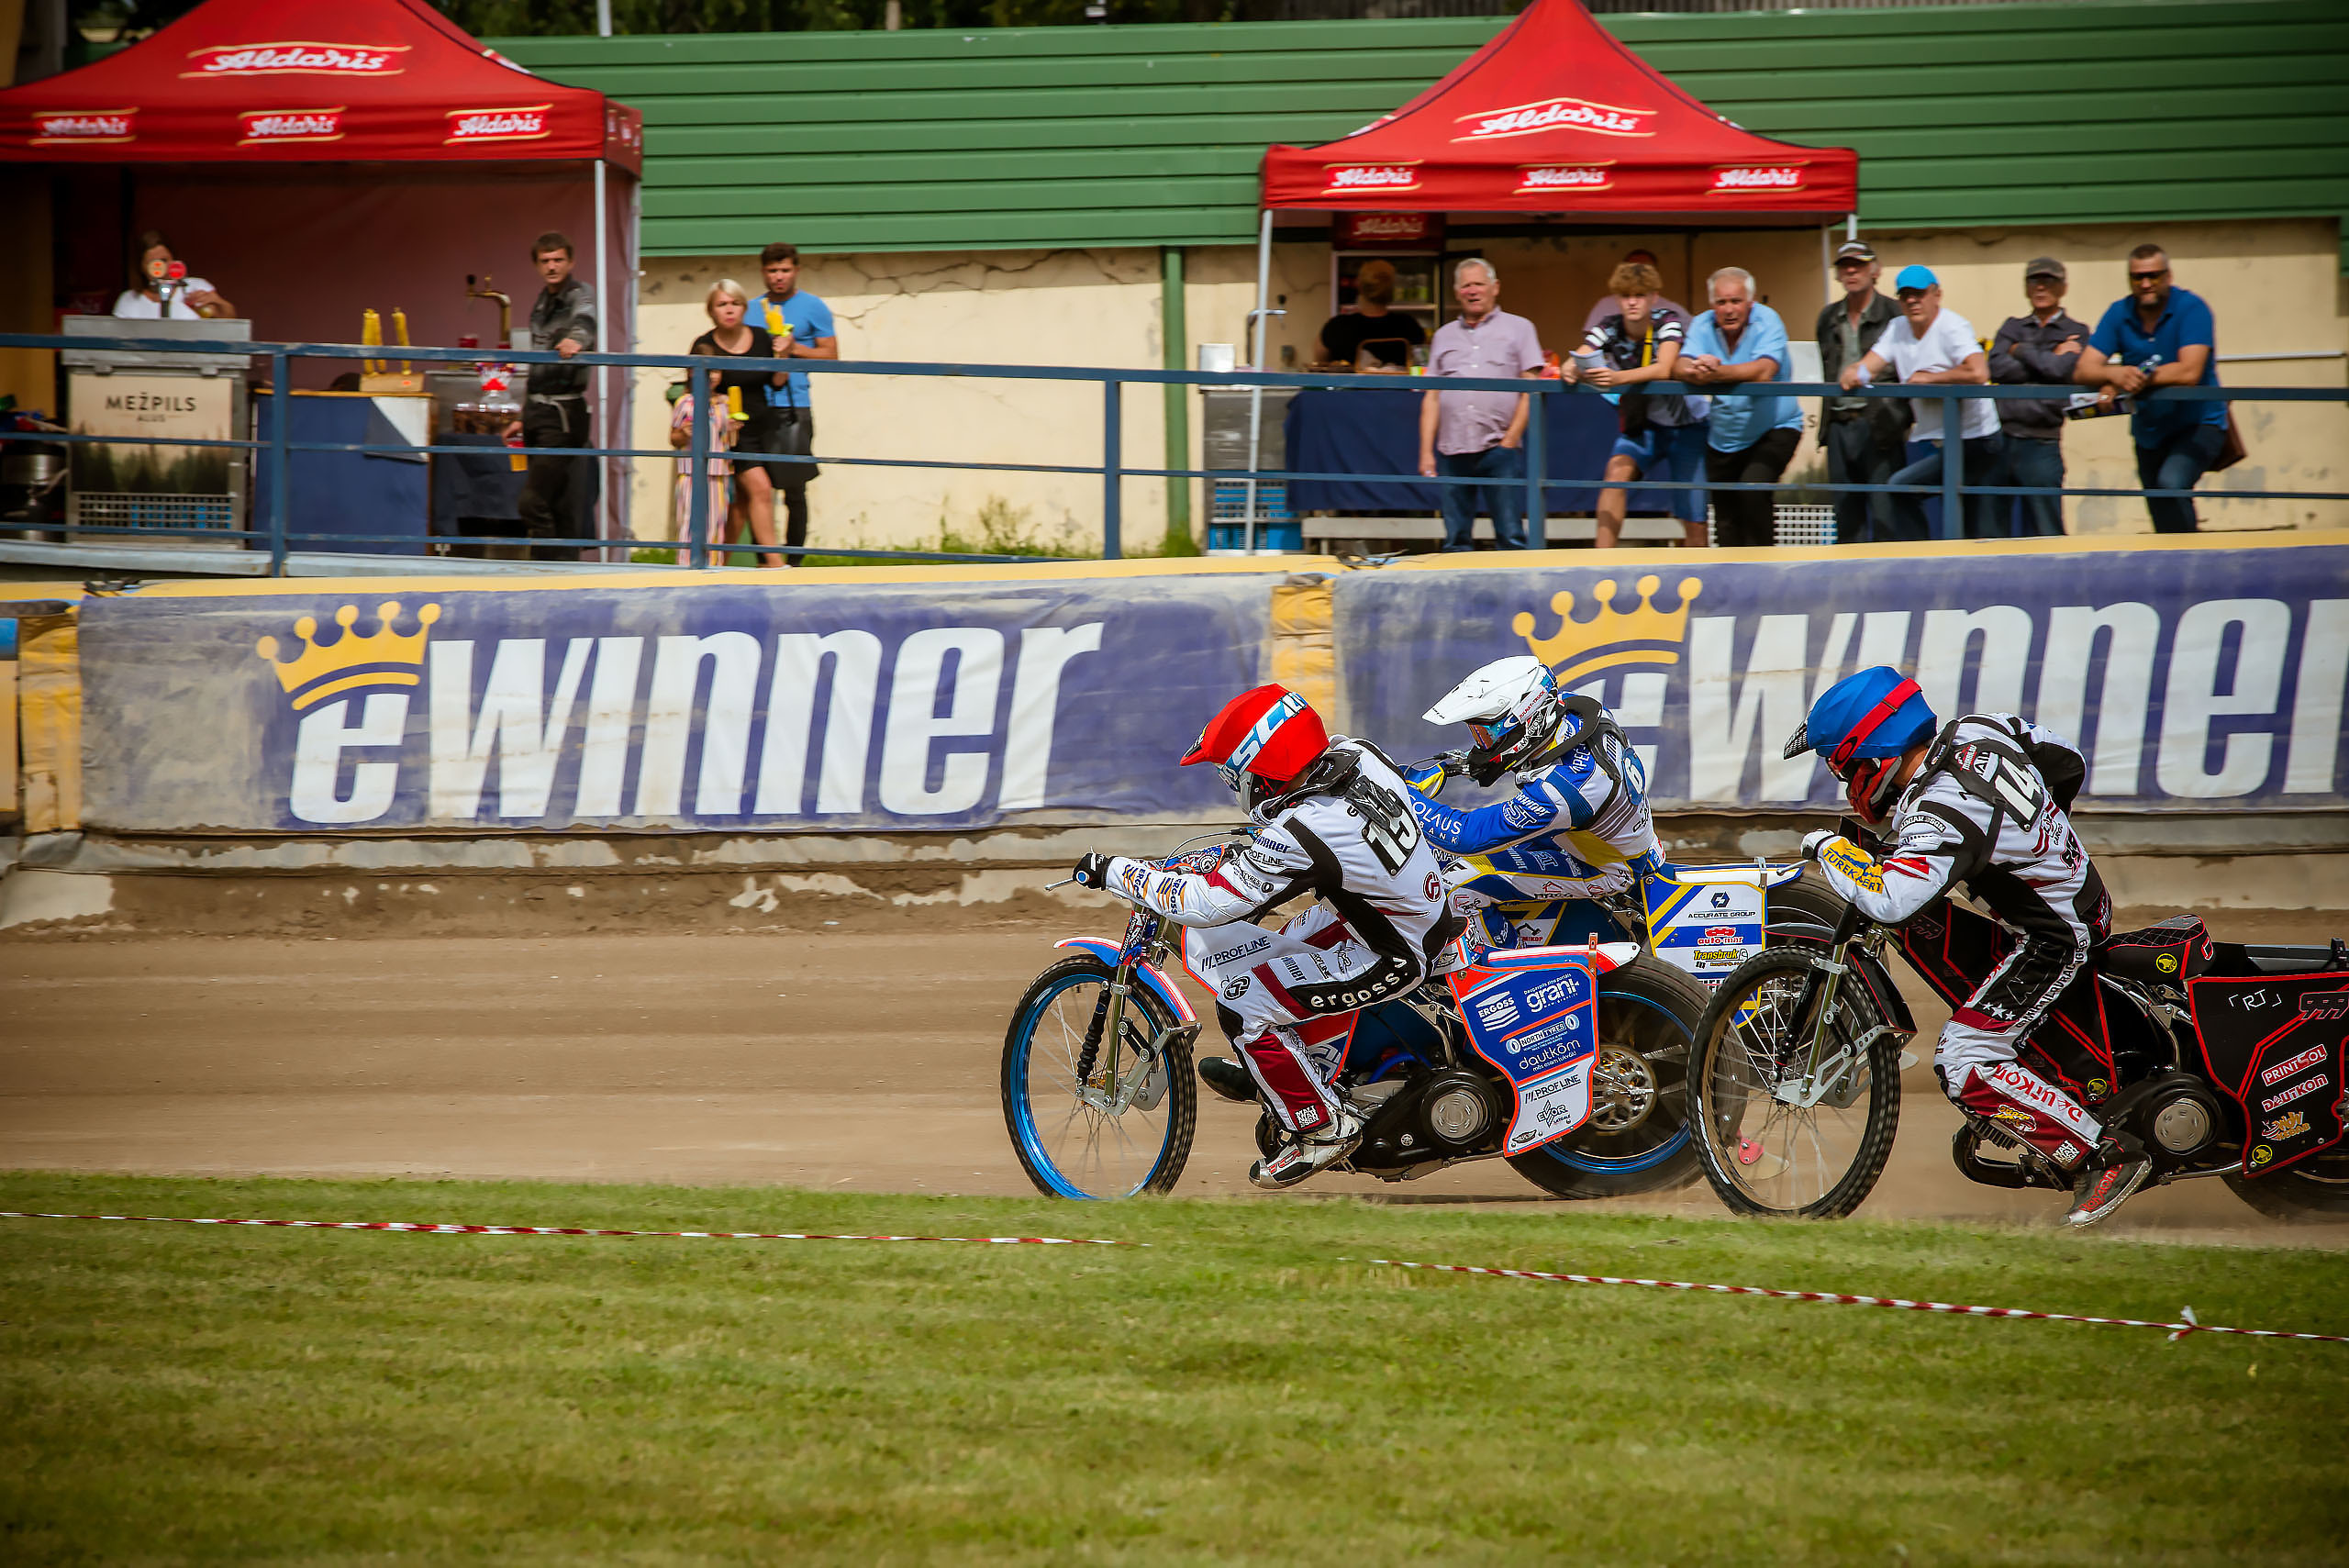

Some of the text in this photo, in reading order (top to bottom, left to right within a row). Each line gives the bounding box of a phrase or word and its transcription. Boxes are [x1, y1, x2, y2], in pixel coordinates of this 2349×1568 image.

[204, 47, 385, 72] Aldaris
[1472, 105, 1638, 134] Aldaris
[105, 392, 197, 411] MEŽPILS
[1995, 756, 2041, 821] 14
[1419, 821, 1459, 844] BANK
[1698, 937, 1743, 945] auto-mar
[1693, 948, 1740, 961] Transbruk
[1478, 997, 1515, 1018] ERGOSS
[1520, 1032, 1542, 1047] NORTH
[1543, 1023, 1564, 1037] TYRES
[2264, 1049, 2326, 1084] PRINTSOL
